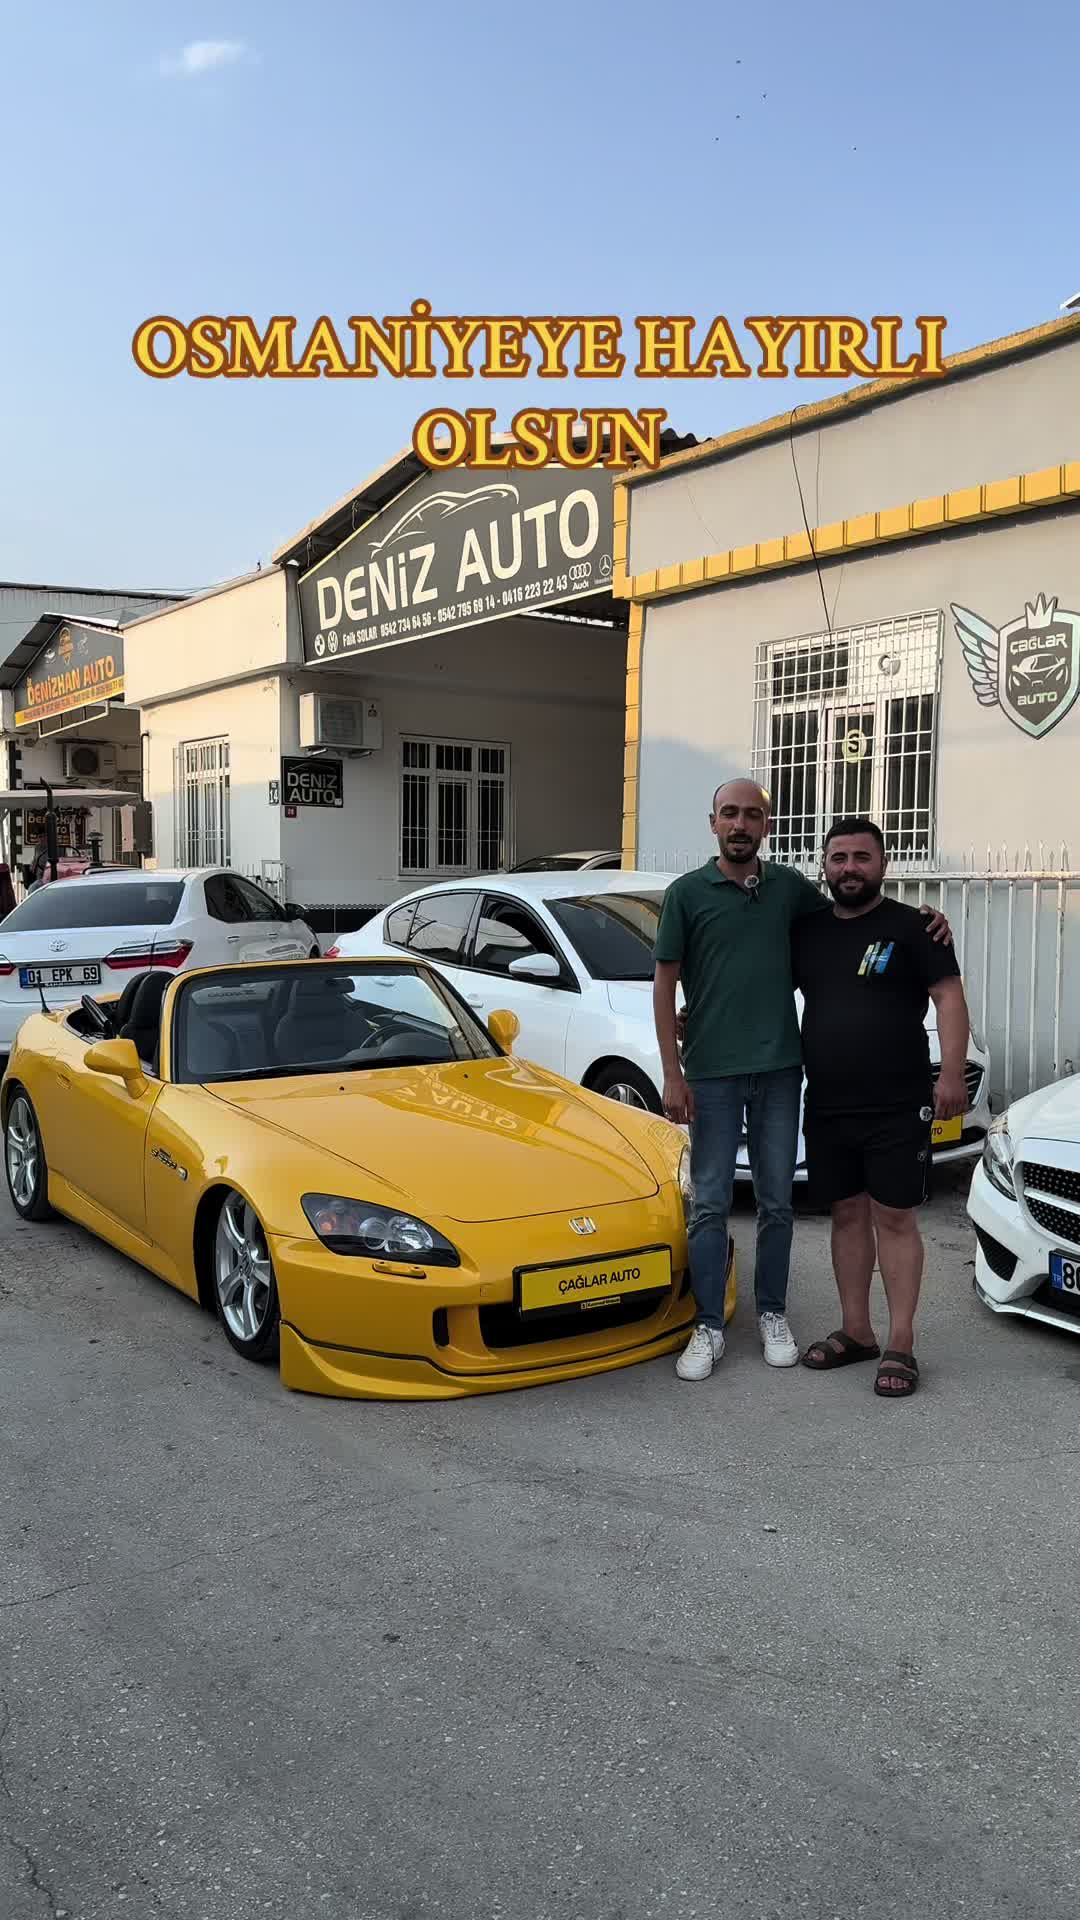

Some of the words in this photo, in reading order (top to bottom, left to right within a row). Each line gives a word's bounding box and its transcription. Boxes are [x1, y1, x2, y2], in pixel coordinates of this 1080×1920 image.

[456, 489, 599, 592] AUTO
[357, 626, 378, 643] SOLAR
[398, 617, 411, 632] 734
[457, 602, 472, 617] 795
[486, 596, 496, 610] 14
[502, 588, 523, 605] 0416
[525, 583, 541, 600] 223
[543, 579, 554, 595] 22
[556, 574, 568, 591] 43
[83, 655, 115, 688] AUTO
[848, 733, 859, 753] S
[270, 789, 278, 804] 14
[289, 787, 335, 804] AUTO
[28, 970, 42, 983] 01
[52, 968, 73, 982] EPK
[83, 967, 98, 980] 69
[558, 1274, 608, 1296] ÇAĞLAR
[609, 1267, 641, 1284] AUTO
